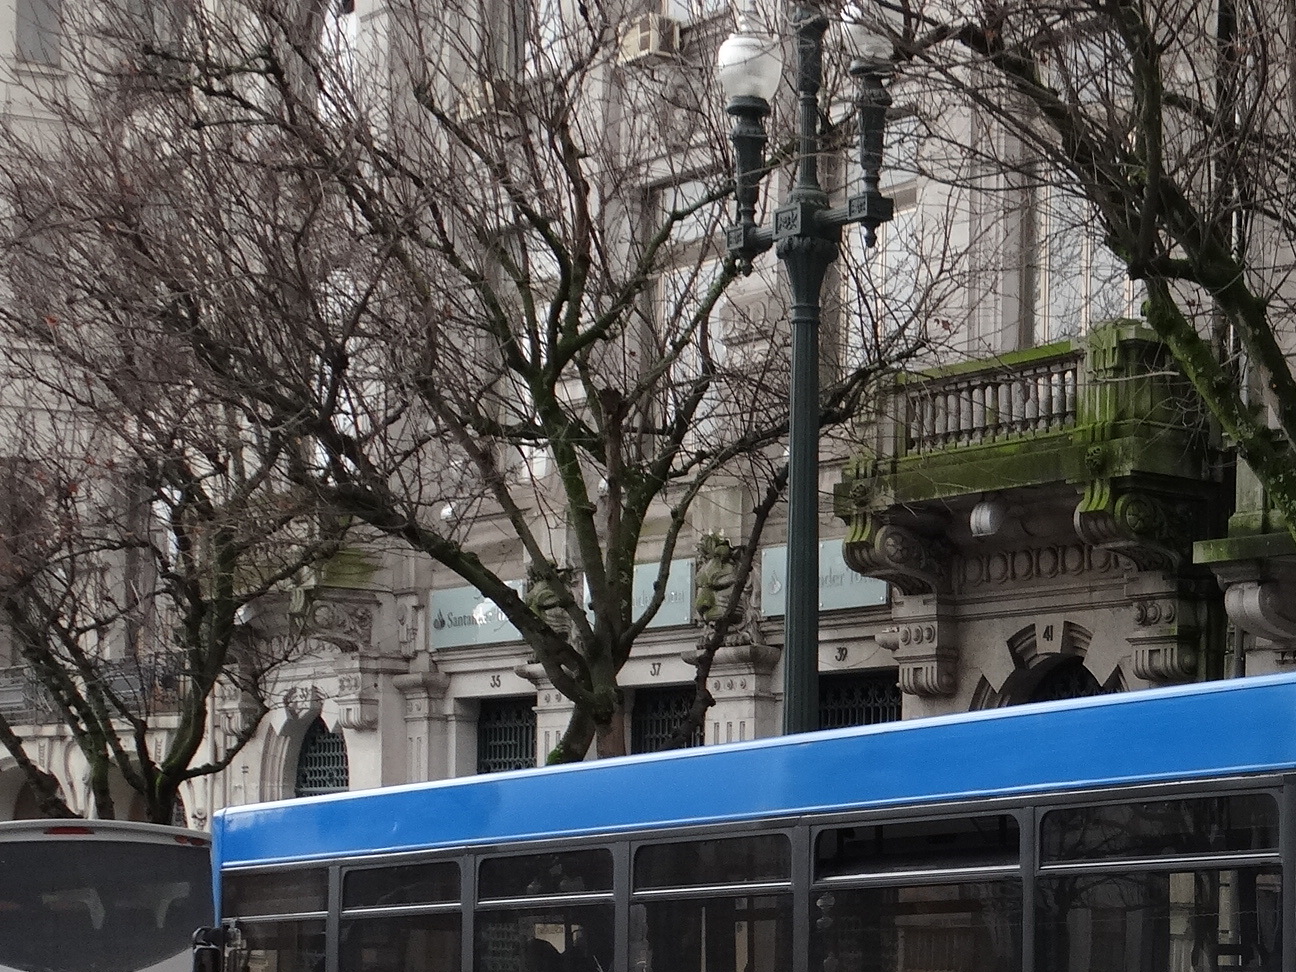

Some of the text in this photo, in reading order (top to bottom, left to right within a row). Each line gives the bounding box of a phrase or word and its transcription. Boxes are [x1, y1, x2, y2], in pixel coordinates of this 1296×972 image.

[1042, 624, 1054, 641] 41
[834, 646, 848, 662] 39
[650, 662, 661, 677] 37
[490, 674, 501, 688] 35
